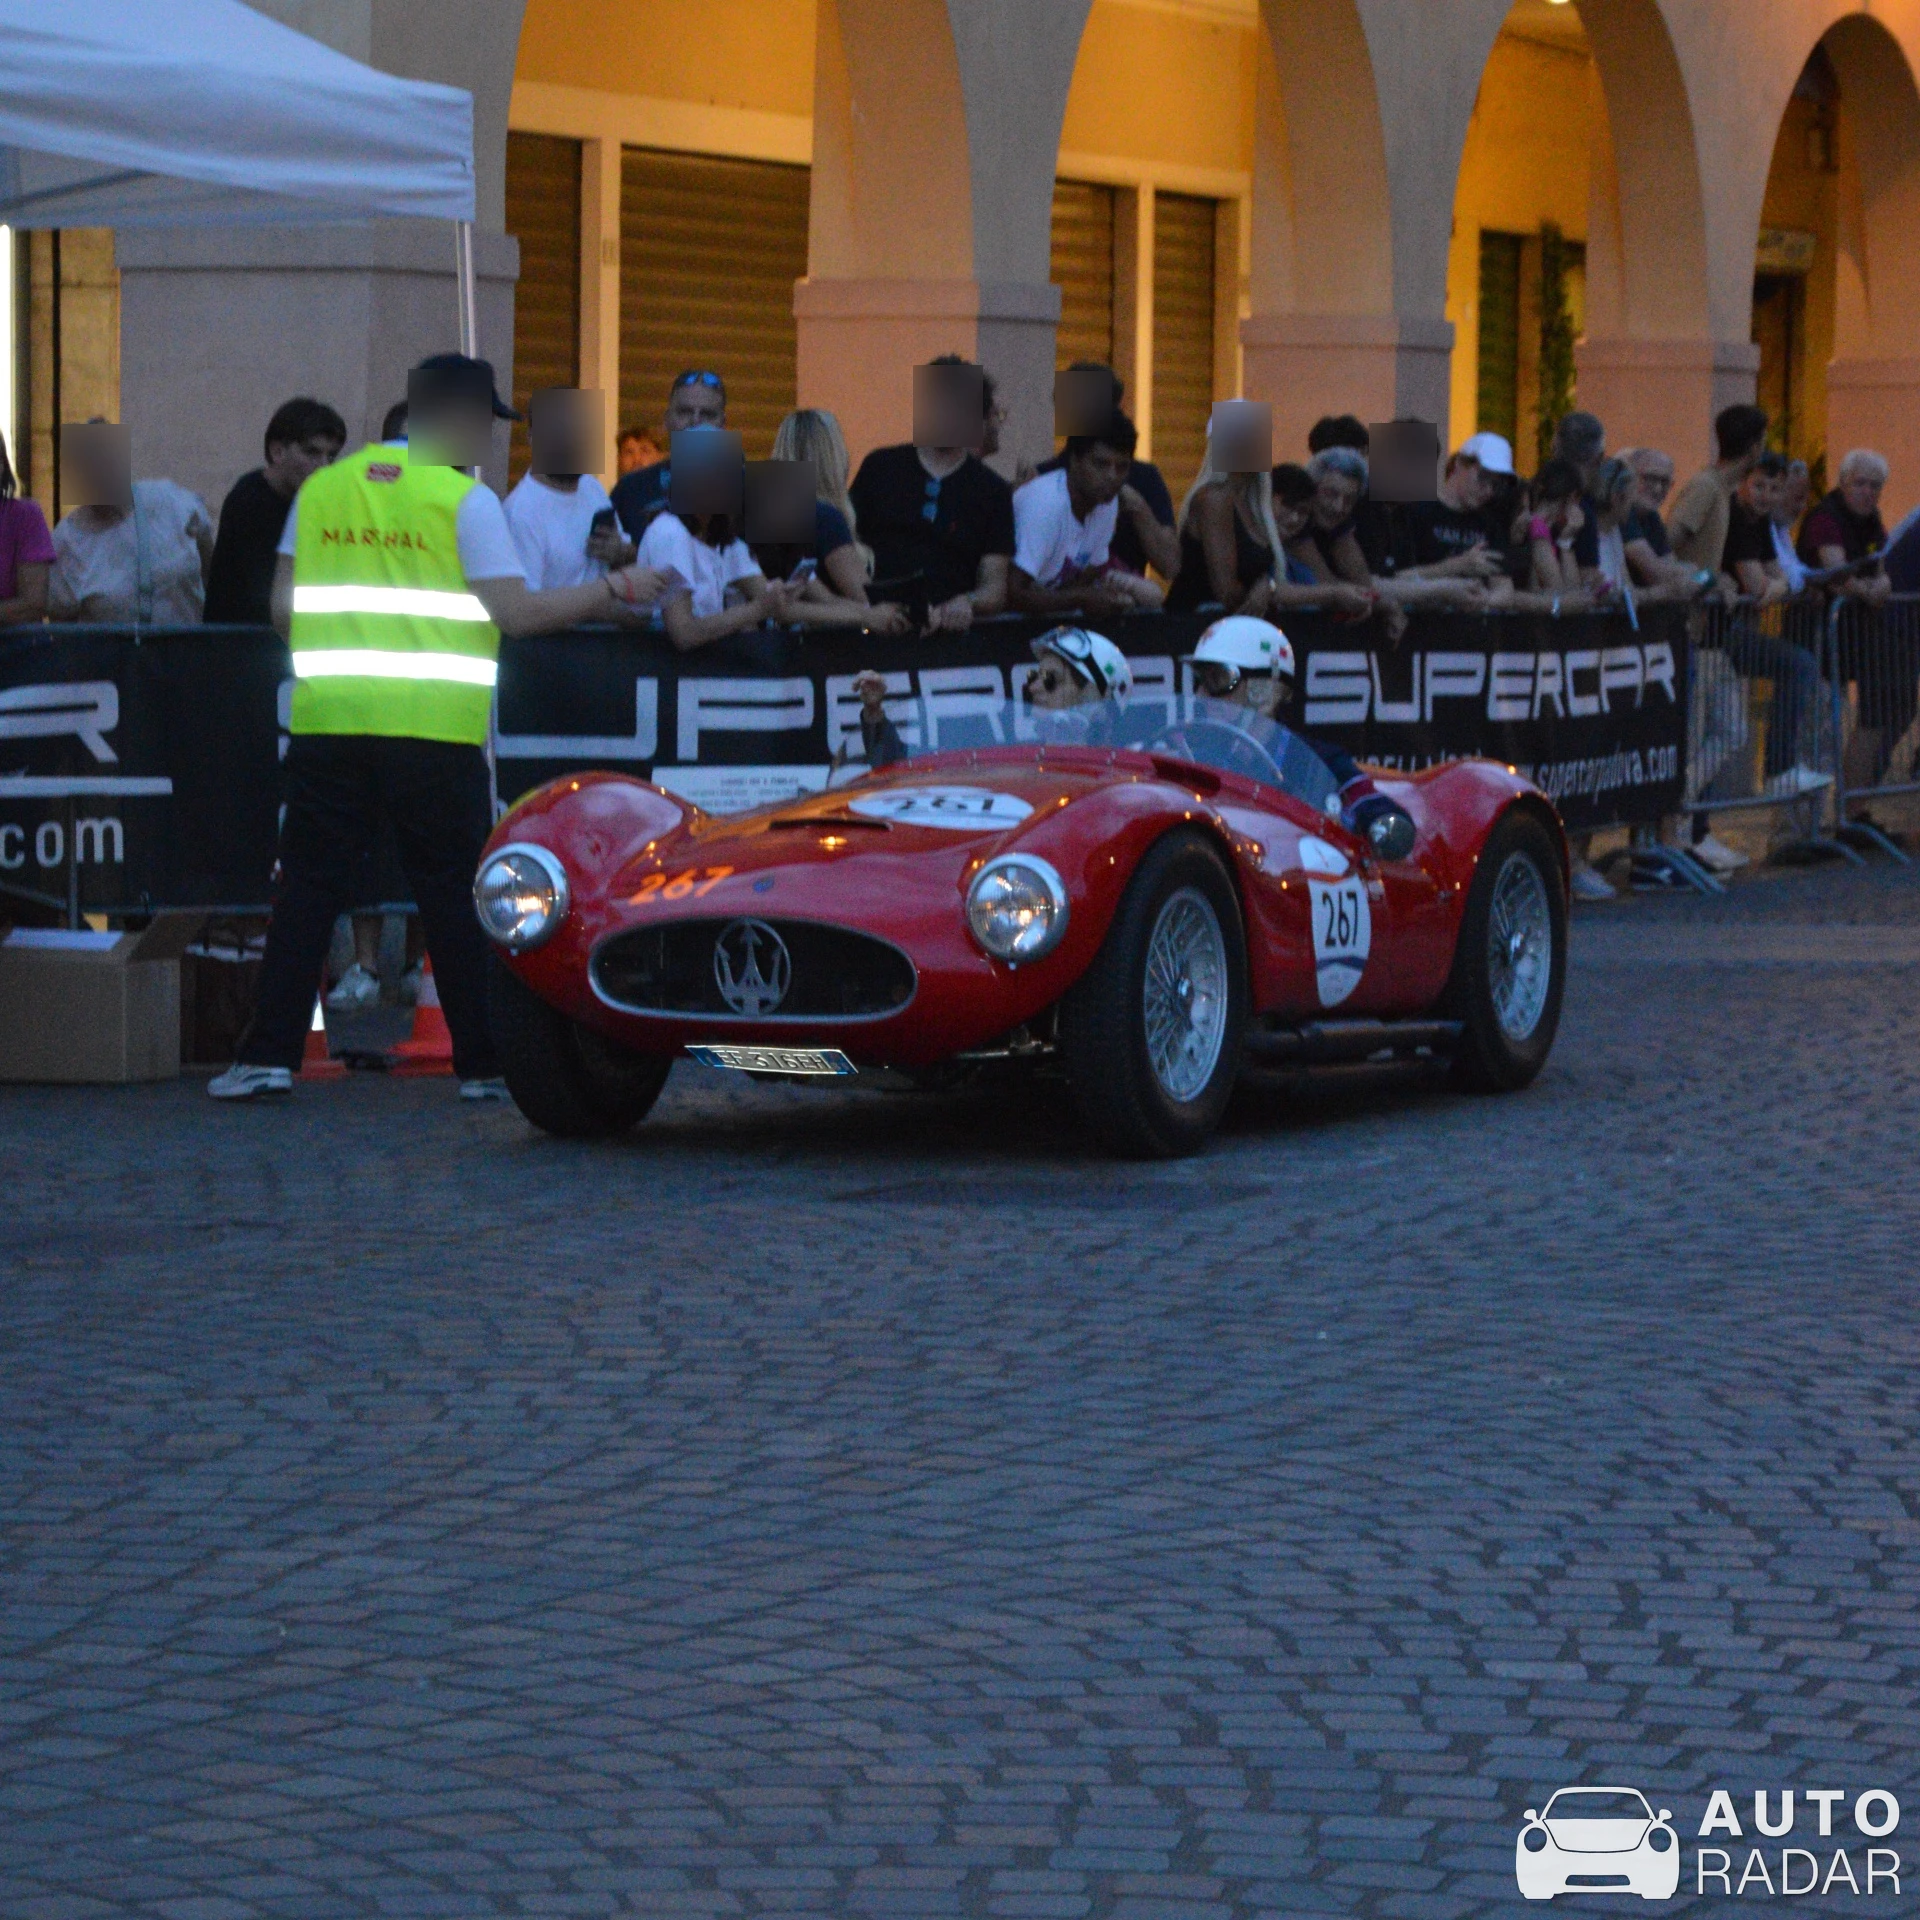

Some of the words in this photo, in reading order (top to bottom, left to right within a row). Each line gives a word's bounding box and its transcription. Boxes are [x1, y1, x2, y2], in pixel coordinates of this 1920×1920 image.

[1304, 642, 1675, 725] SUPERCAR
[628, 865, 734, 905] 267
[1322, 891, 1359, 947] 267
